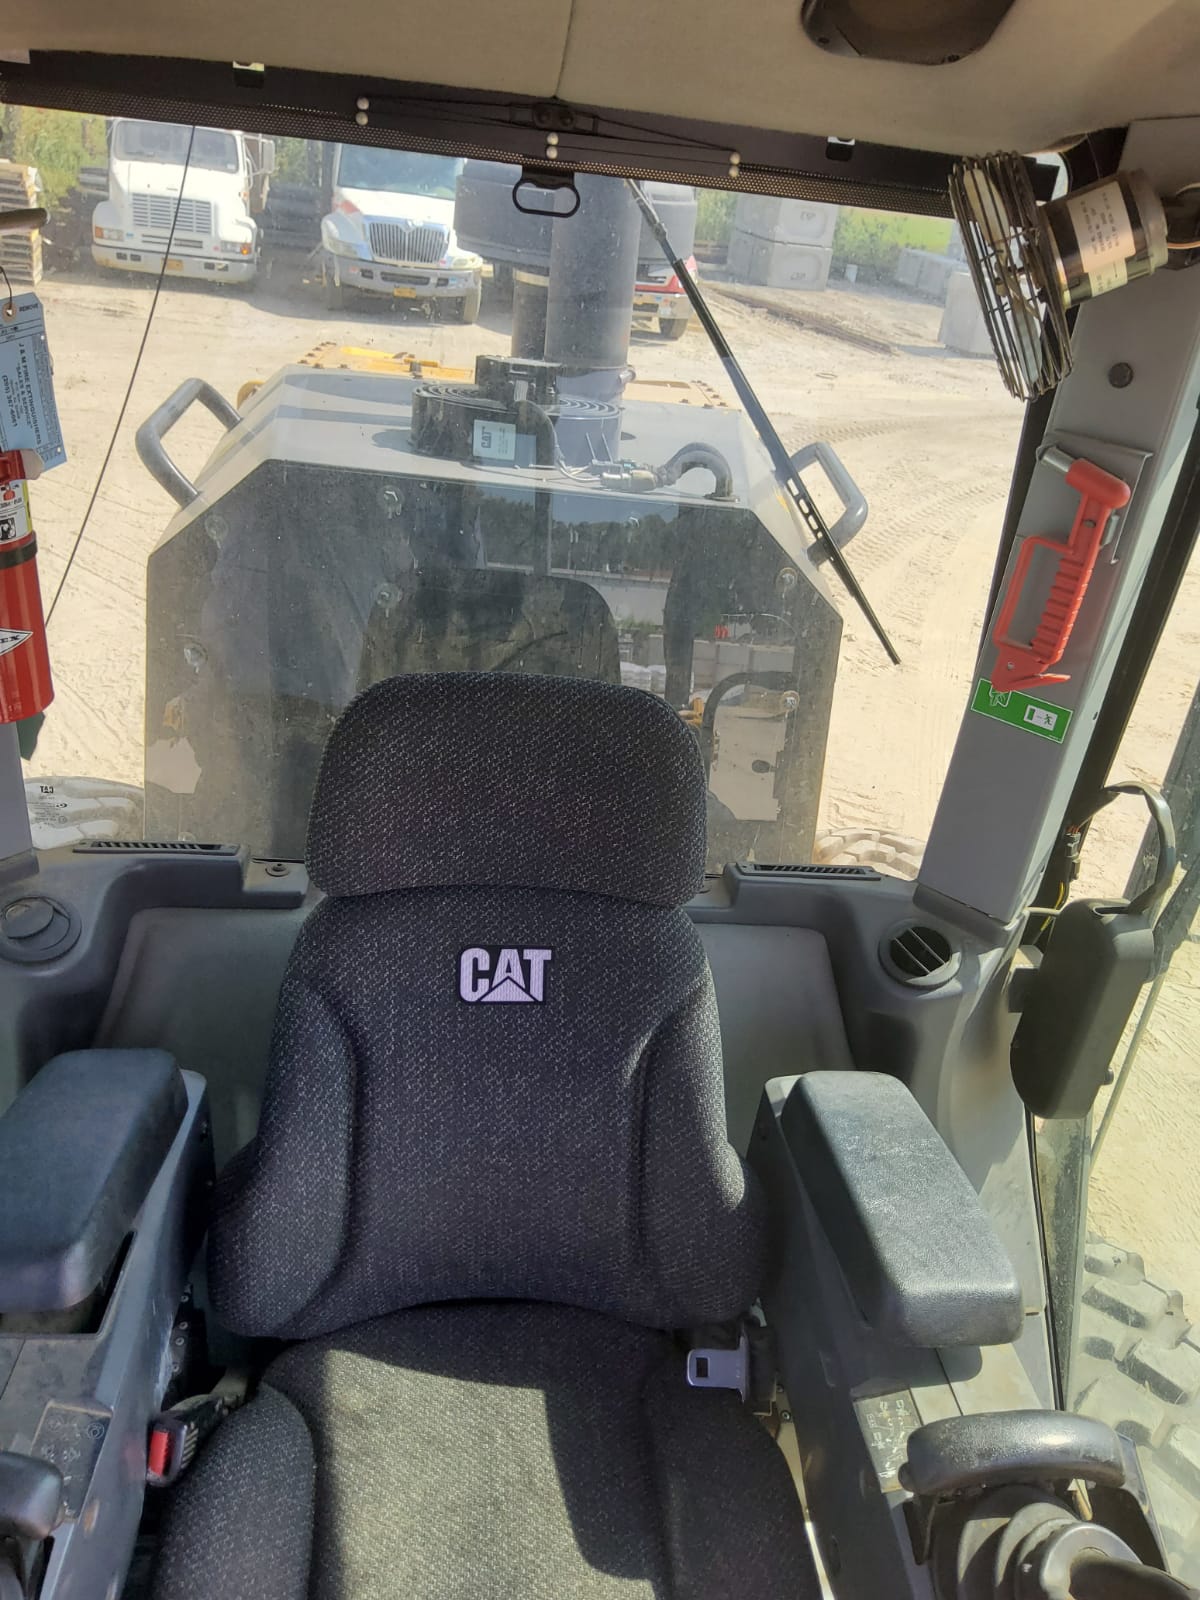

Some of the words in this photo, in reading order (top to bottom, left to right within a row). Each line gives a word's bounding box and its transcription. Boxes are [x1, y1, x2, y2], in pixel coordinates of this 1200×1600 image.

[22, 364, 30, 383] FIRE
[25, 384, 41, 445] EXTINGUISHERS
[481, 426, 492, 448] CAT
[460, 947, 552, 1002] CAT
